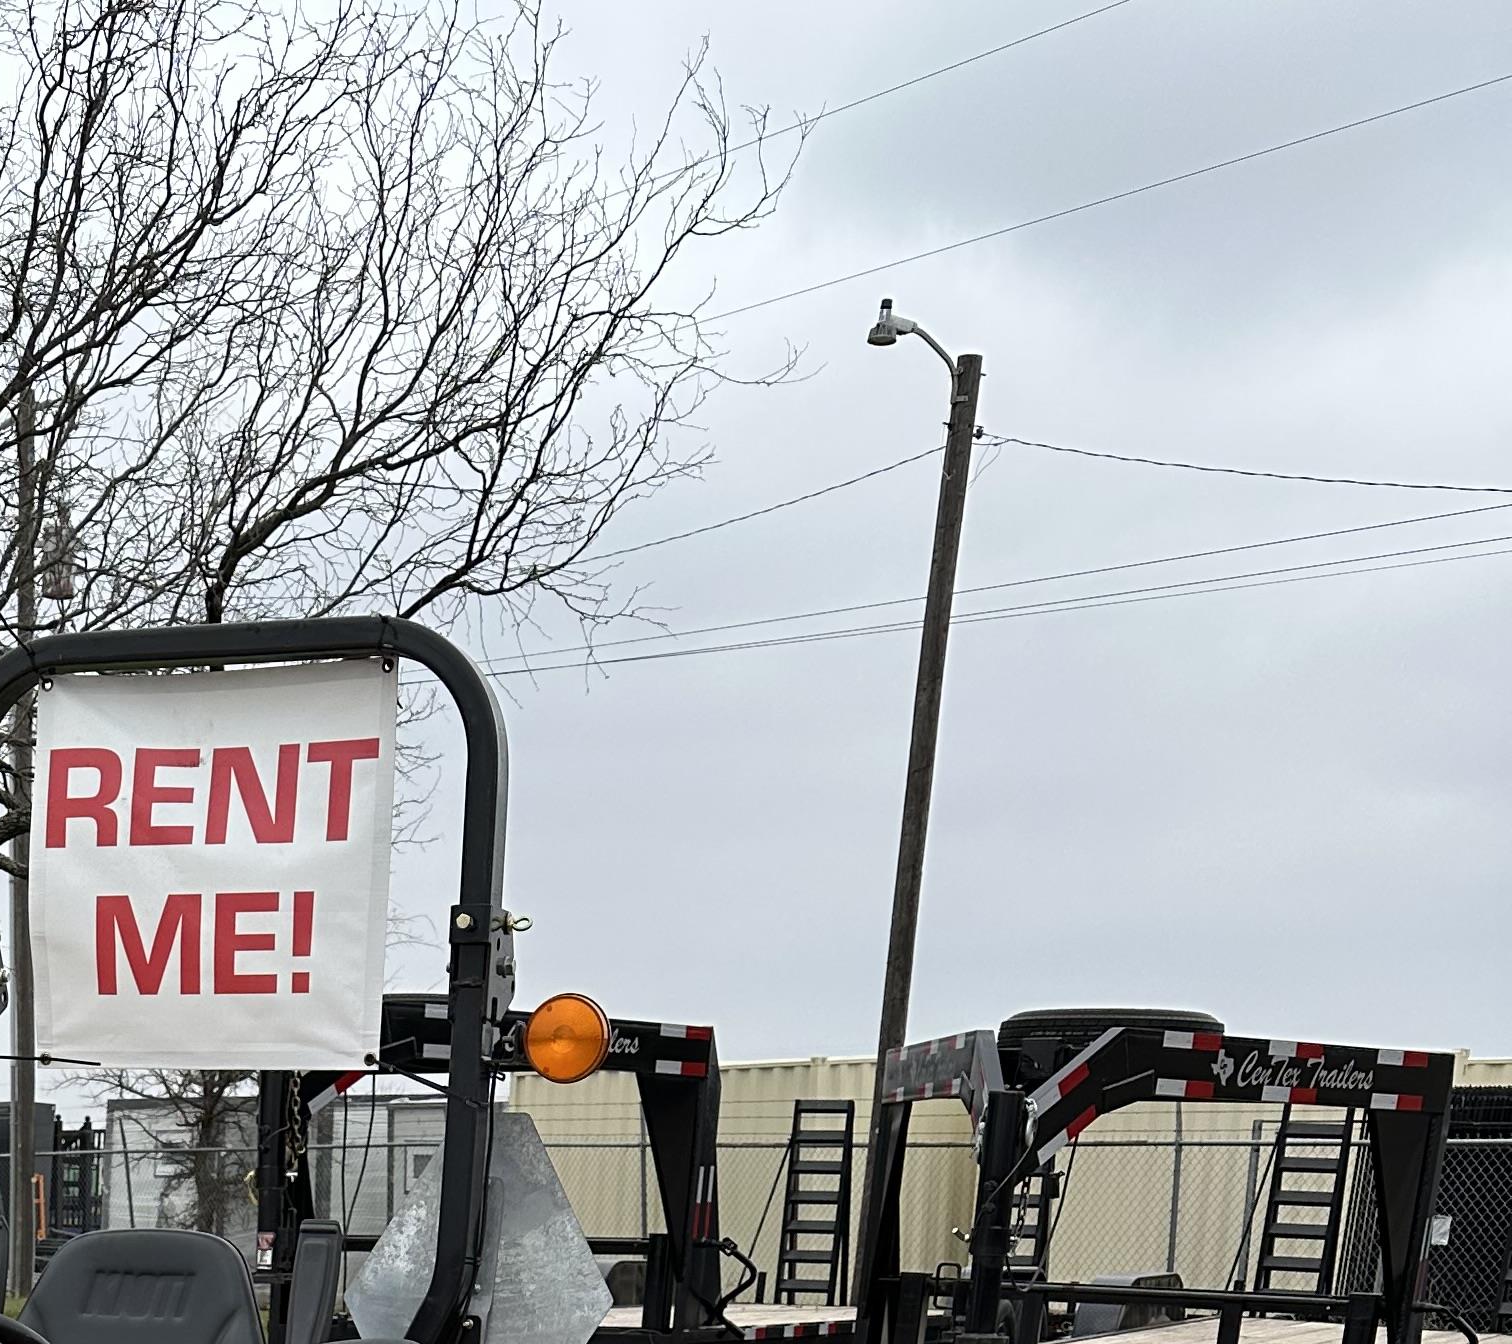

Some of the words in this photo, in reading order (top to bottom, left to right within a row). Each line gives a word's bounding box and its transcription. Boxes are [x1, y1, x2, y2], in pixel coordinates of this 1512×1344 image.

[45, 738, 380, 848] RENT
[96, 891, 314, 995] ME!
[1238, 1050, 1301, 1088] CenTex
[1307, 1055, 1374, 1090] Trailers
[79, 1267, 197, 1321] KIOTI
